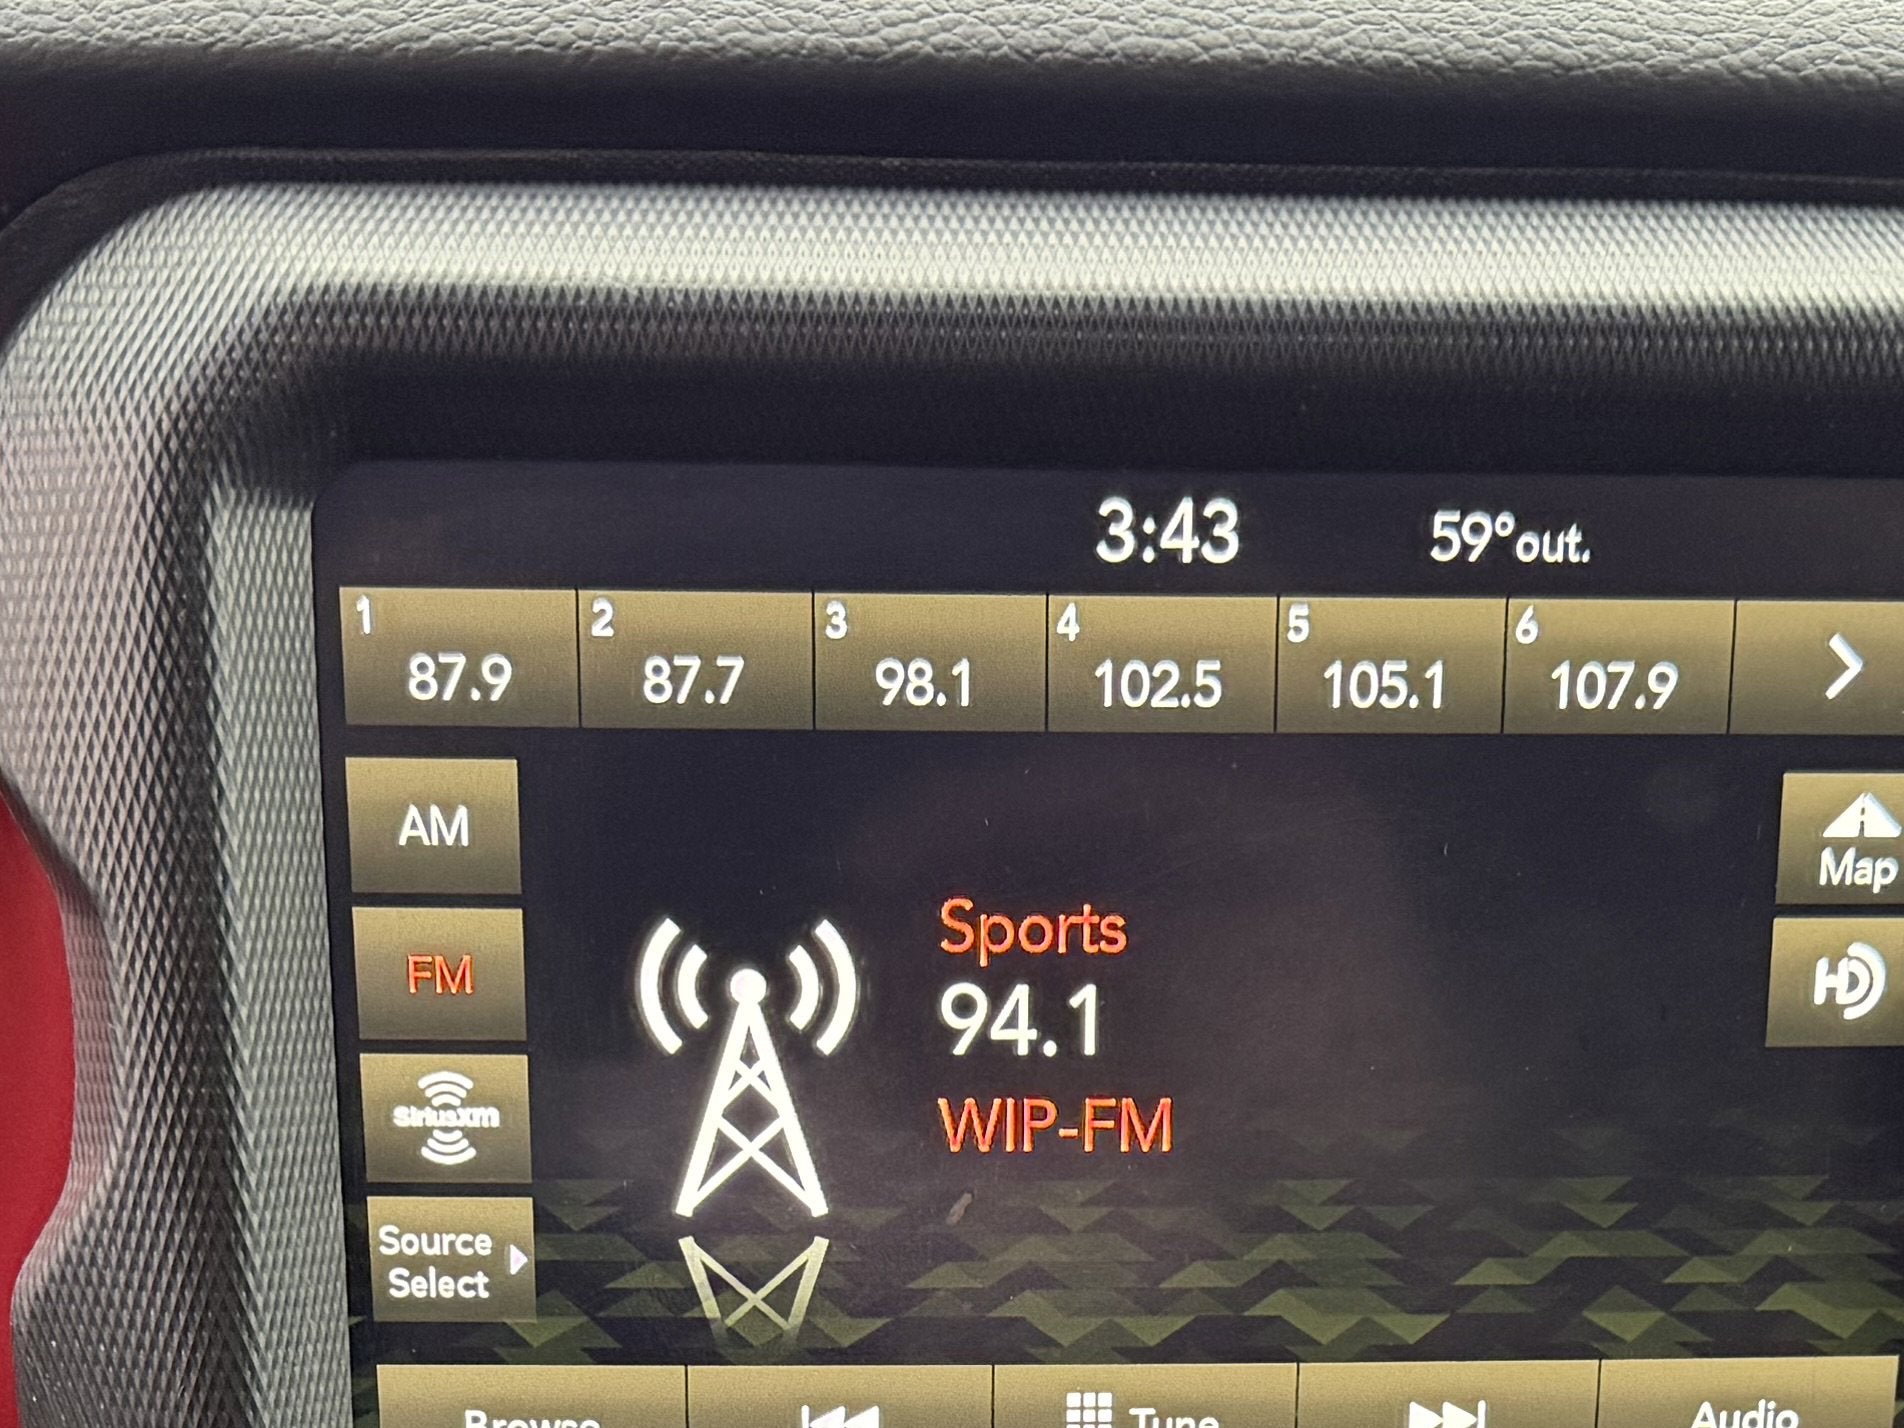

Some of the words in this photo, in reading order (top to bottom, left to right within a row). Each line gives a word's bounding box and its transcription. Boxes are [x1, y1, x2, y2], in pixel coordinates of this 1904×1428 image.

[1096, 497, 1239, 564] 3:43
[355, 597, 372, 635] 1
[591, 600, 614, 638] 2
[825, 603, 847, 640] 3
[1056, 602, 1080, 642] 4
[1287, 604, 1310, 643] 5
[1515, 605, 1539, 644] 6
[408, 653, 512, 704] 87.9
[643, 655, 744, 706] 87.7
[875, 658, 973, 708] 98.1
[1095, 659, 1223, 709] 102.5
[1323, 660, 1444, 710] 105.1
[1550, 660, 1679, 710] 107.9
[398, 805, 469, 848] AM
[1819, 846, 1899, 894] Map
[939, 896, 1128, 967] Sports
[407, 955, 474, 996] FM
[940, 982, 1099, 1056] 94.1
[938, 1097, 1173, 1153] WIP-FM
[379, 1225, 493, 1257] Source
[388, 1268, 490, 1299] Select
